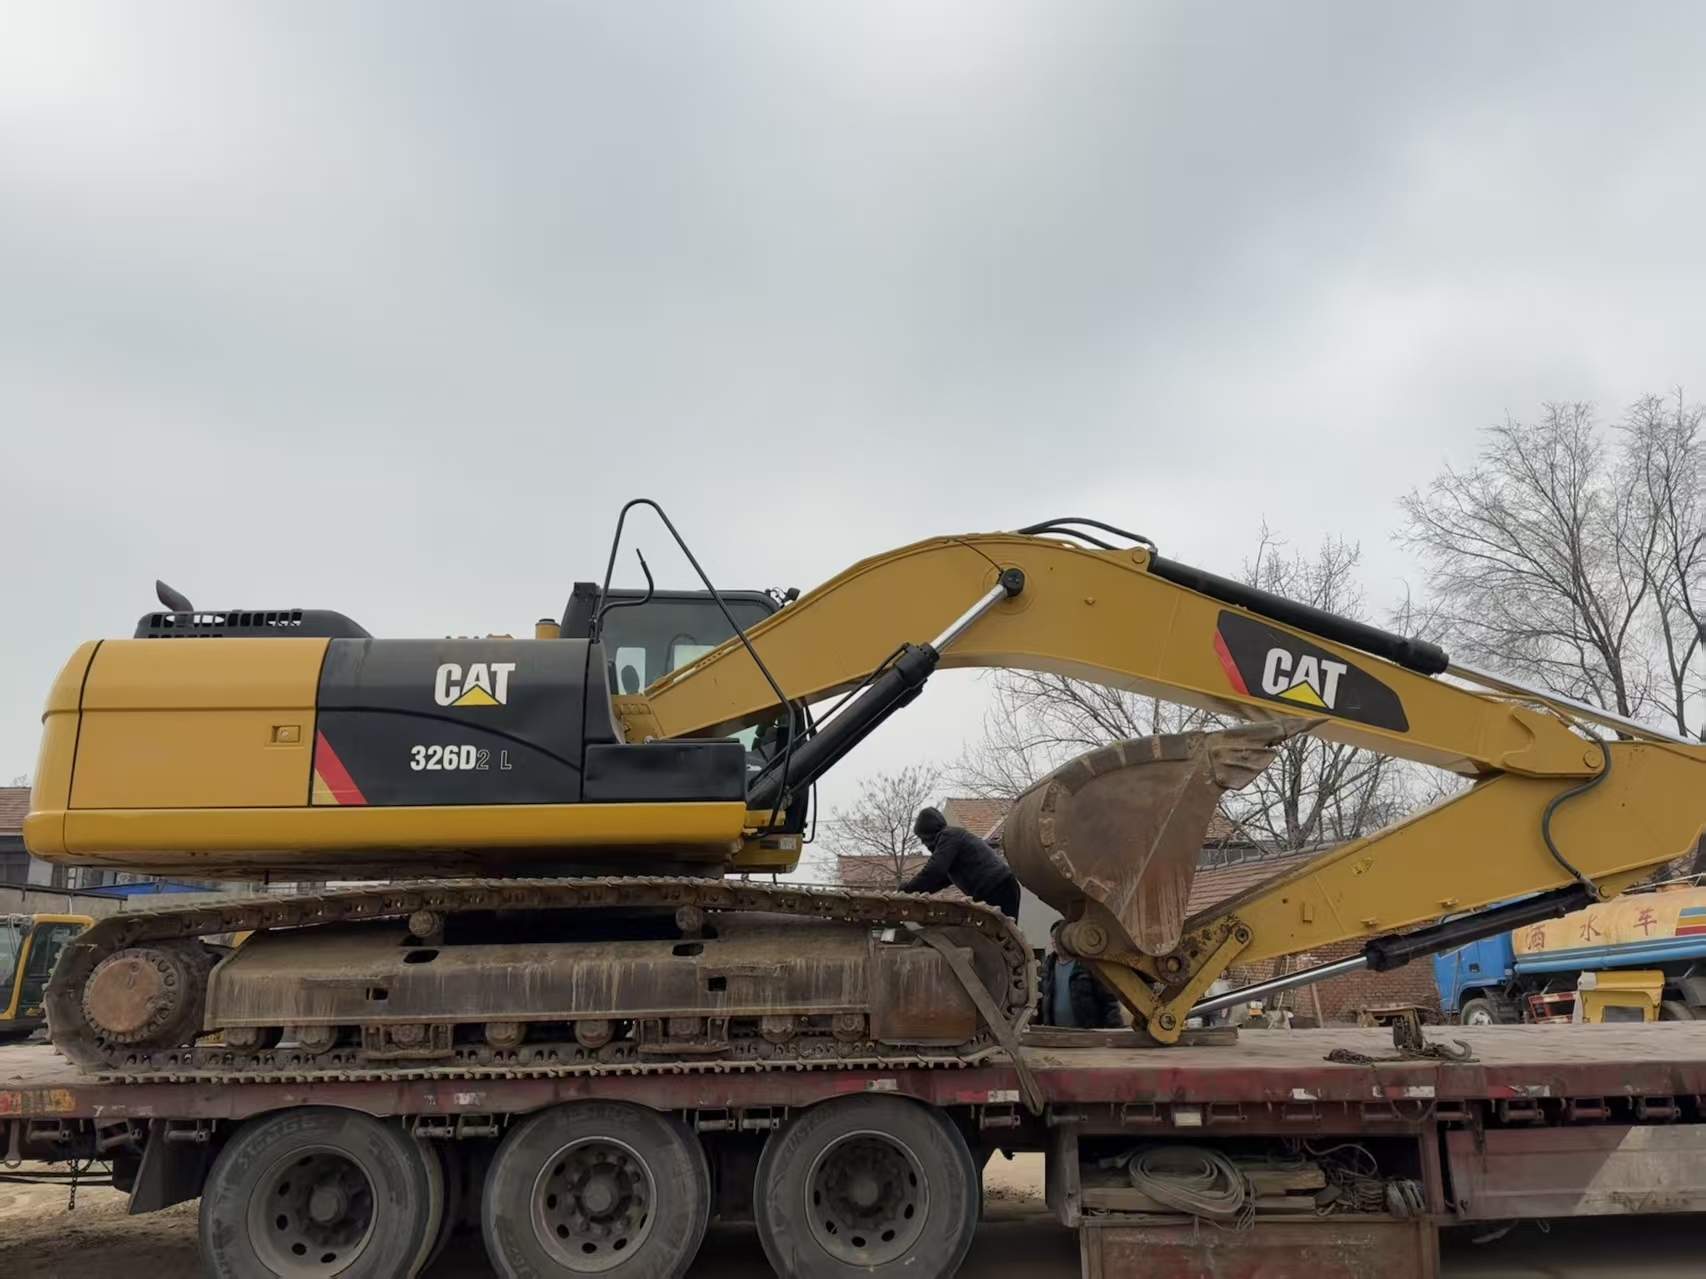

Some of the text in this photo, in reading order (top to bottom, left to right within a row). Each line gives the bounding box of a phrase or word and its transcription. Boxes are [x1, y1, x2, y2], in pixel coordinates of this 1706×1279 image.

[434, 663, 516, 706] CAT
[1262, 648, 1348, 710] CAT
[501, 751, 512, 770] L
